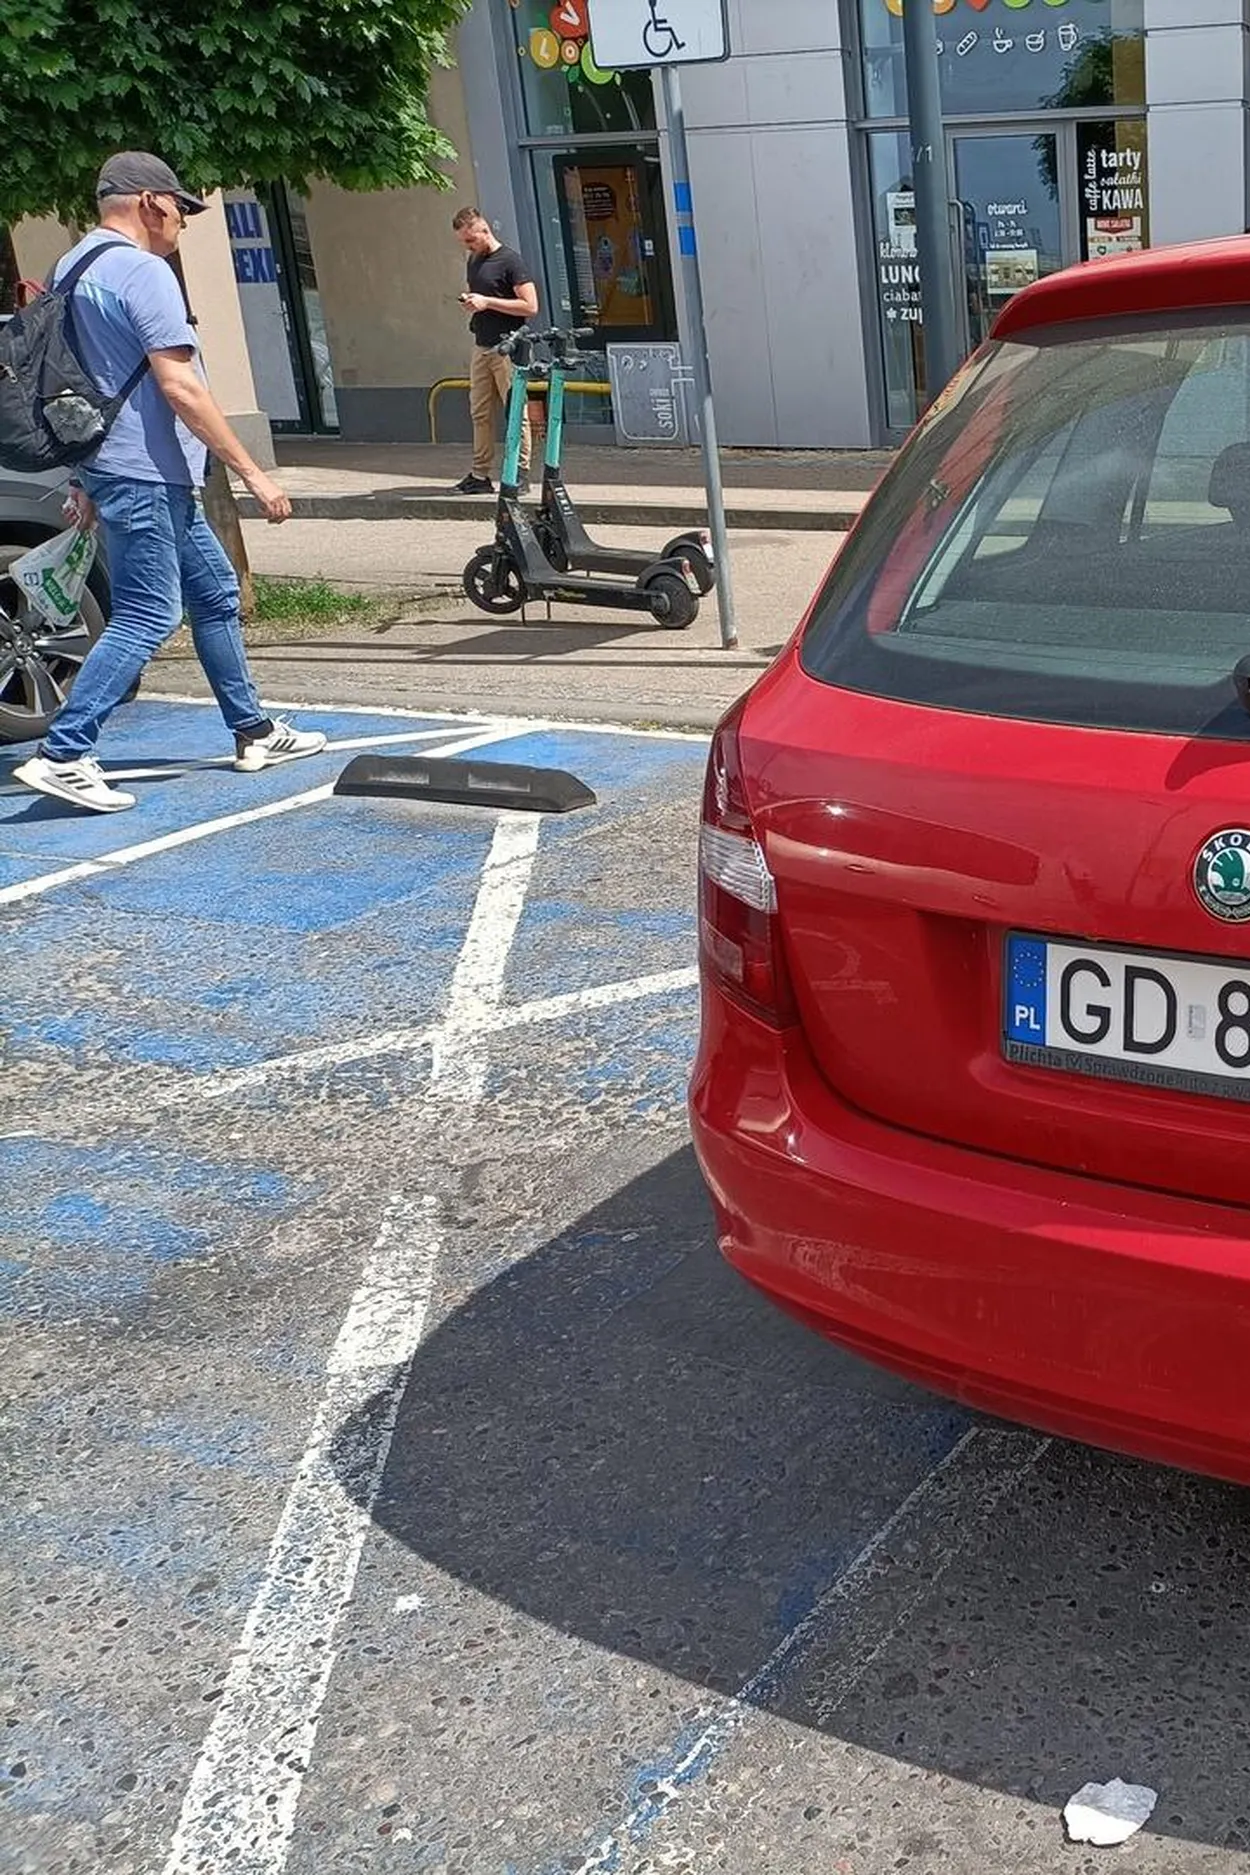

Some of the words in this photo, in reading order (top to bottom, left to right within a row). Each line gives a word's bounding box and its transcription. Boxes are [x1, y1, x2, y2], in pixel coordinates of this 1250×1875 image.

[1100, 148, 1141, 170] tarty
[1101, 188, 1144, 211] KAWA
[651, 398, 674, 429] soki
[1015, 1005, 1041, 1031] PL
[1060, 957, 1178, 1055] GD
[1008, 1043, 1057, 1066] Plichta
